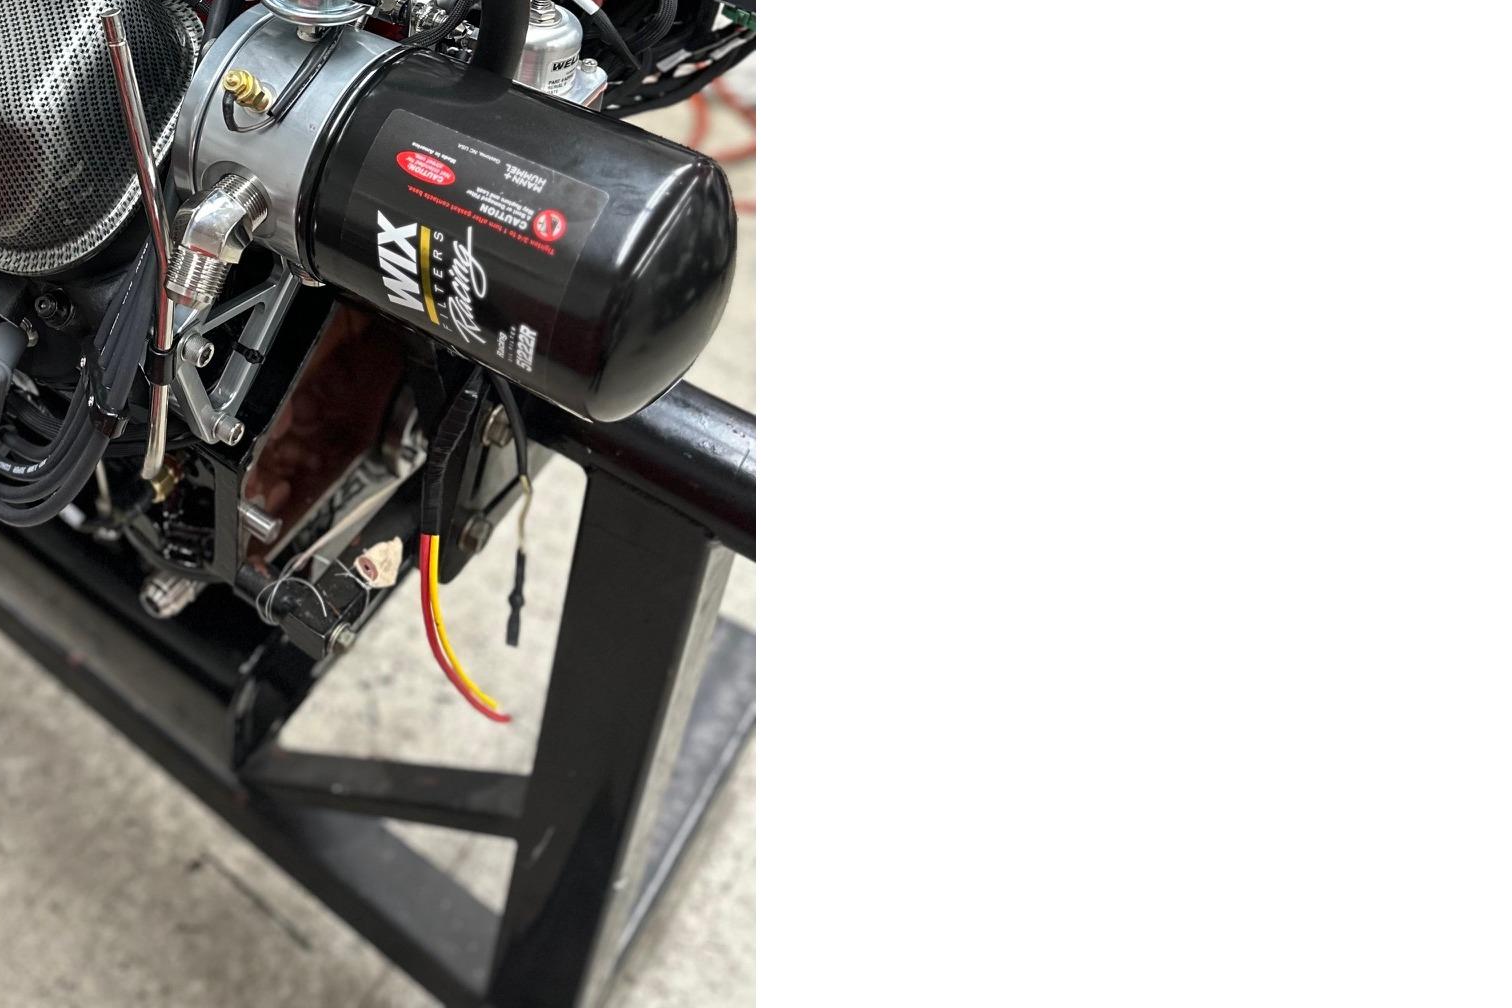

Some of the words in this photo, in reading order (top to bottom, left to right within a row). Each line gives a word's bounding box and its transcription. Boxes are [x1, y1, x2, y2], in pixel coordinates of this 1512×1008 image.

[411, 140, 434, 155] America
[441, 153, 456, 164] Made
[457, 142, 469, 151] USA
[503, 163, 546, 186] HUMMEL
[478, 202, 527, 230] CAUTION
[377, 210, 419, 312] WIX
[433, 230, 452, 333] FILTERS
[448, 225, 487, 345] Racing
[496, 330, 508, 358] Racing
